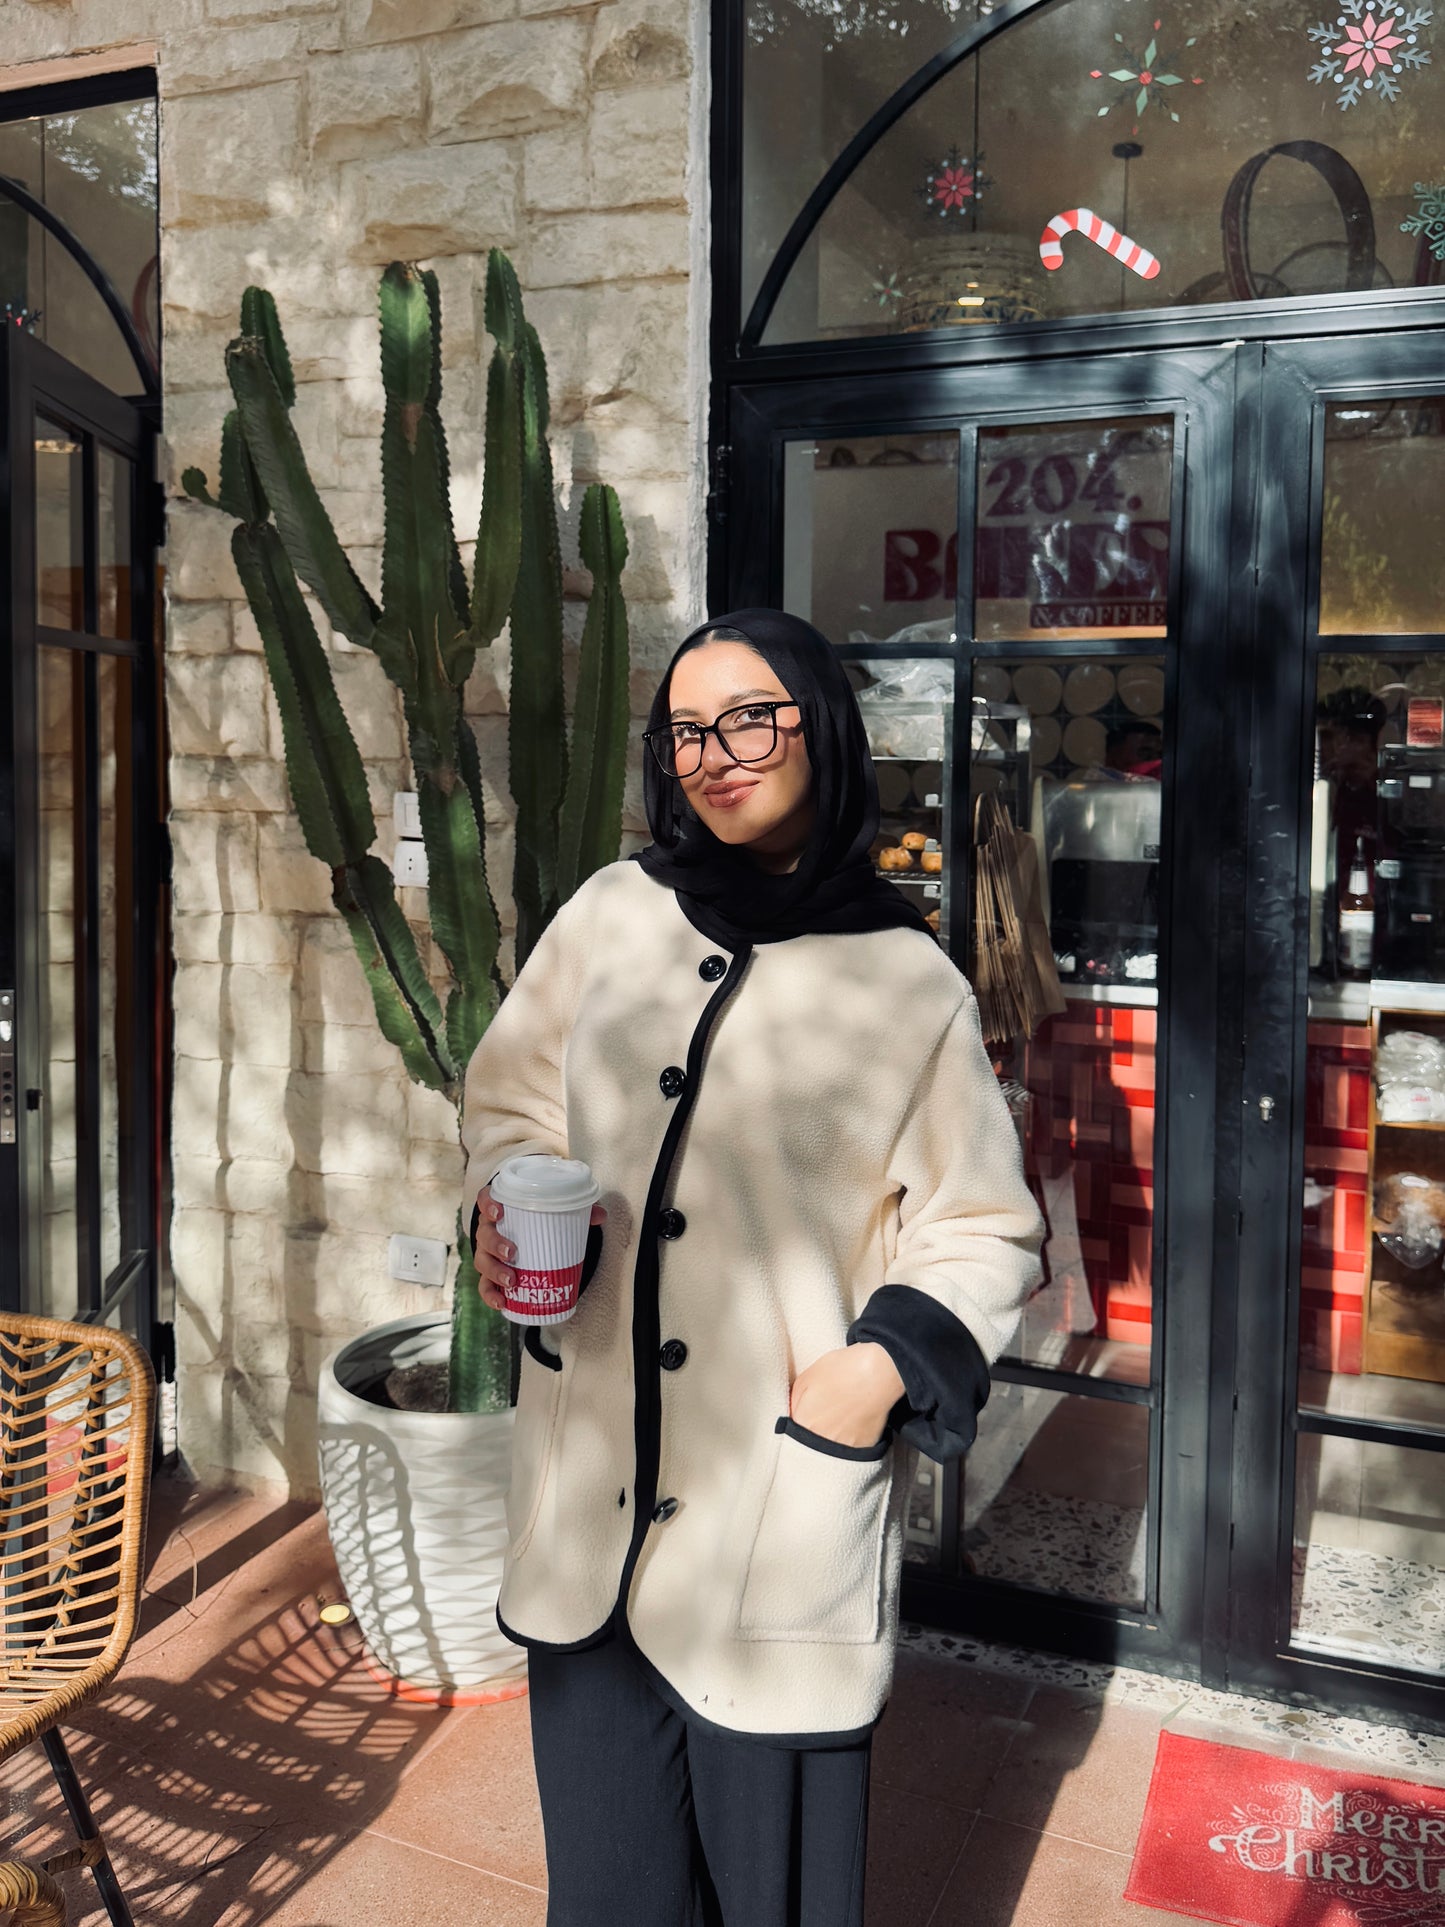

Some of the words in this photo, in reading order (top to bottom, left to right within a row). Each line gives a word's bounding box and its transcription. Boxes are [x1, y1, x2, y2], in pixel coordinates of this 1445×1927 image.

[985, 454, 1142, 516] 204.
[1060, 605, 1166, 626] COFFEE
[504, 1284, 573, 1304] BAKERY
[1301, 1786, 1445, 1845] Merr
[1208, 1824, 1445, 1893] Christ
